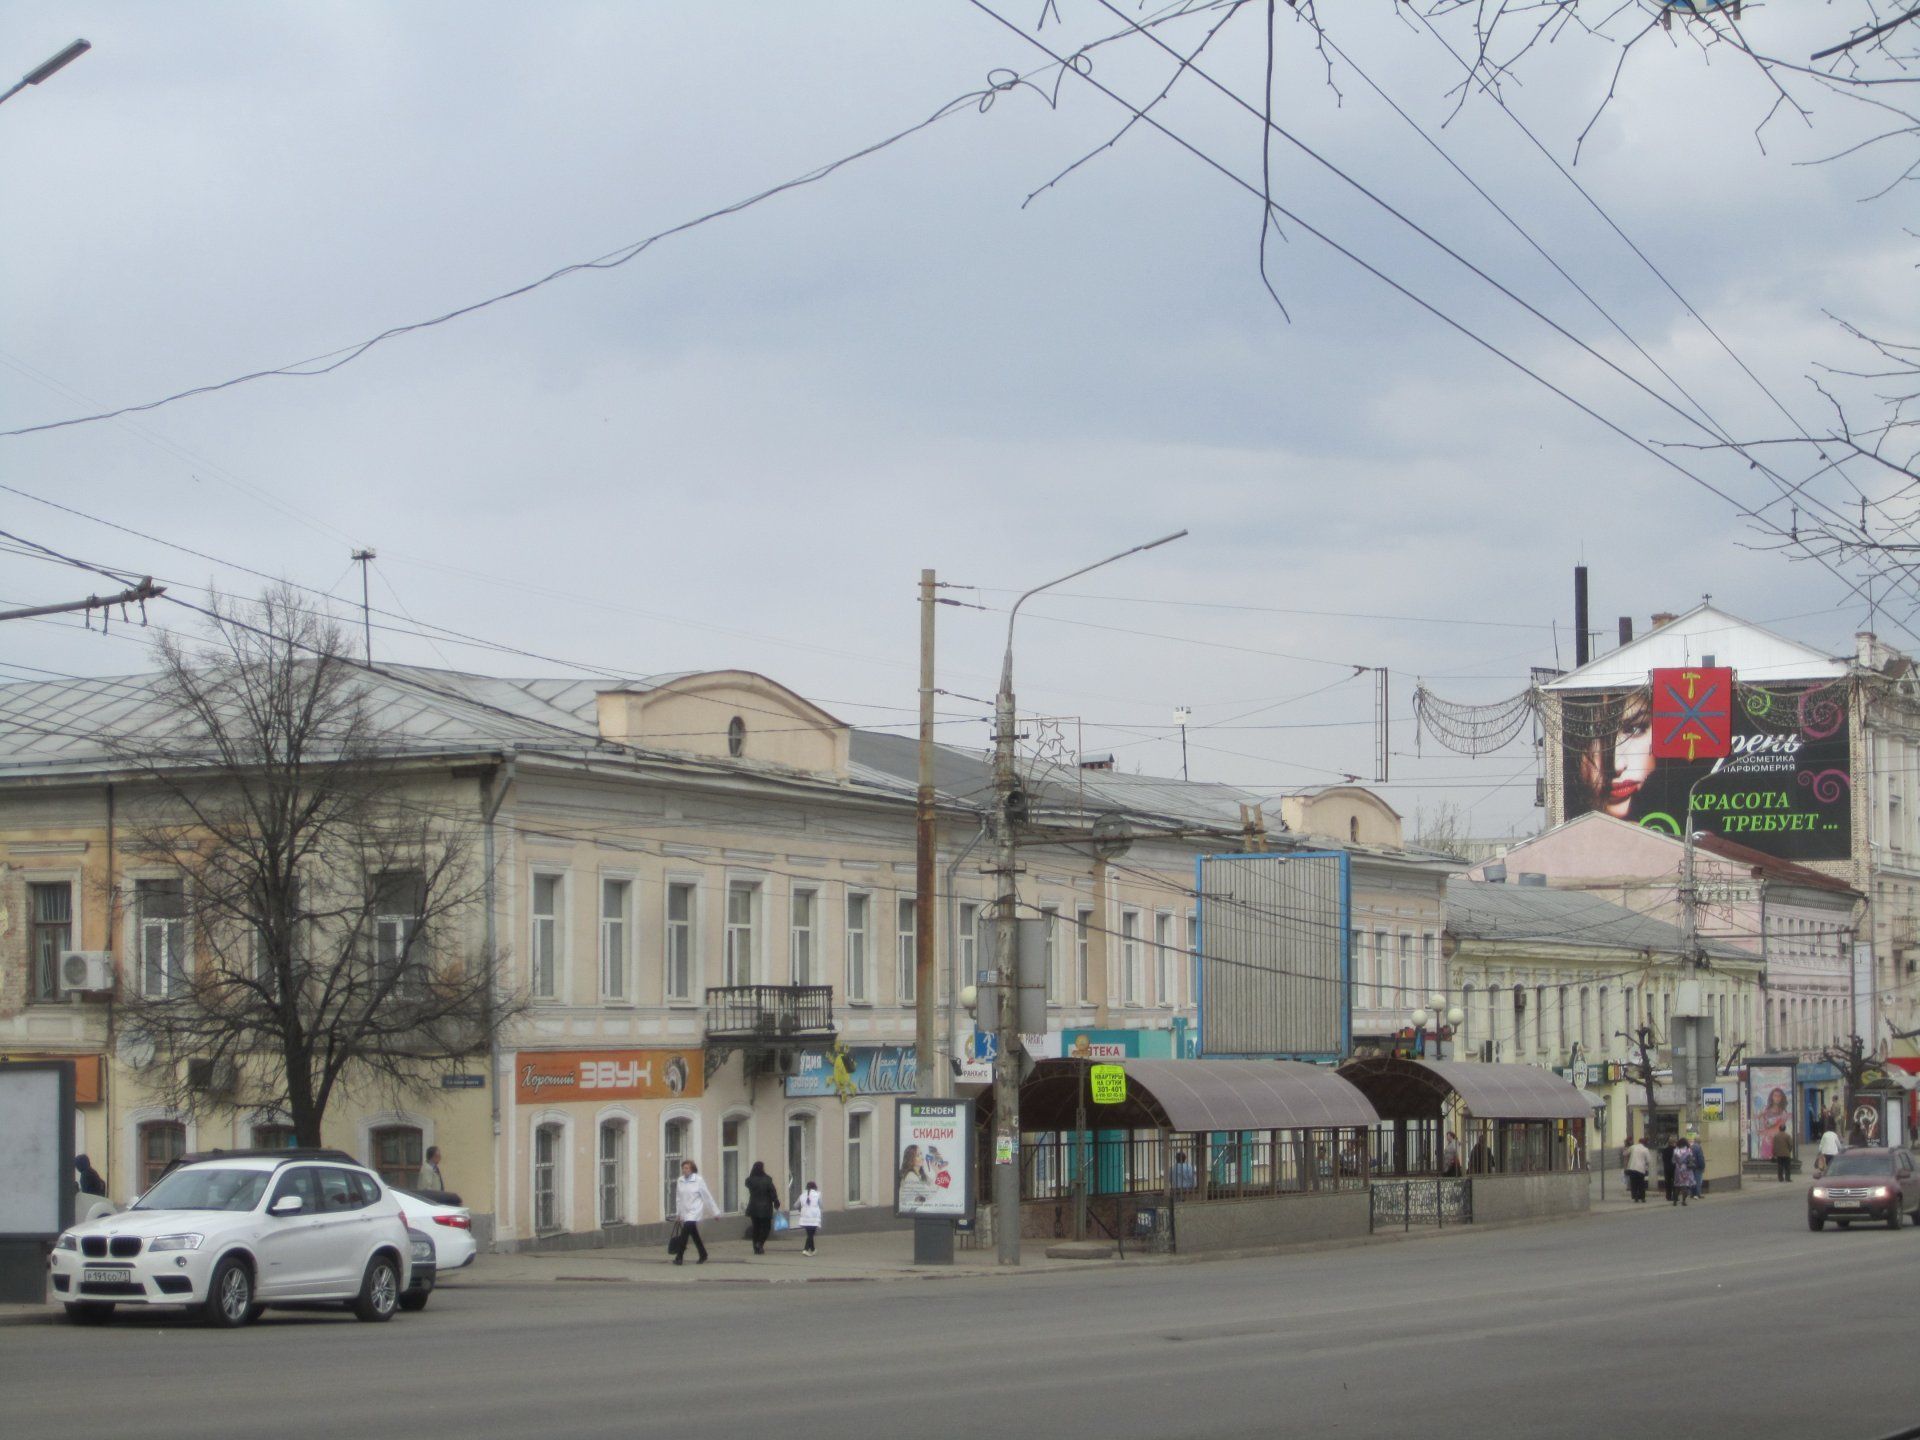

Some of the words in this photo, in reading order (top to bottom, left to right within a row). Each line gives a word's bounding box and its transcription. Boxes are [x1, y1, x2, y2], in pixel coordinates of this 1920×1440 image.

[1736, 754, 1795, 764] КОСМЕТИКА
[1723, 764, 1796, 773] ПАРФЮМЕРИЯ
[1689, 792, 1791, 811] КРАСОТА
[1723, 813, 1819, 832] ТРЕБУЕТ
[920, 1106, 954, 1115] ZENDEN
[913, 1128, 954, 1140] СКИДКИ
